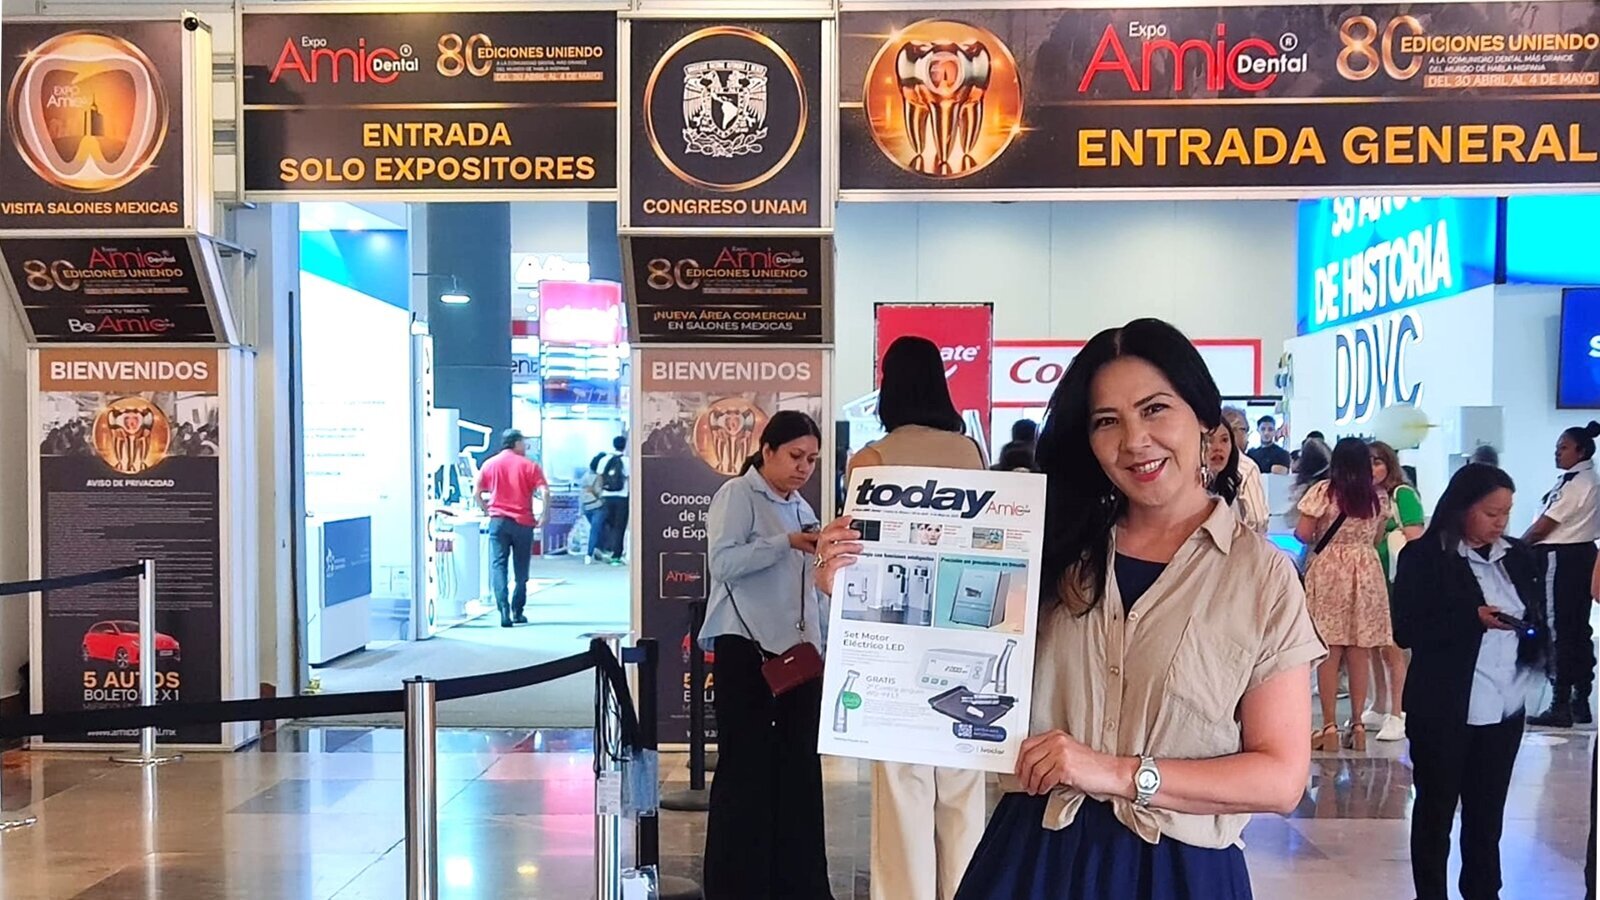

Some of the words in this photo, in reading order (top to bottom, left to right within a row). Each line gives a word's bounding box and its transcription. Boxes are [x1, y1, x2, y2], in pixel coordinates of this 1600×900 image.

[1129, 22, 1167, 37] Expo
[302, 36, 327, 48] Expo
[1336, 16, 1422, 80] 80
[1401, 35, 1504, 53] EDICIONES
[1509, 33, 1600, 51] UNIENDO
[269, 37, 400, 84] Amic
[373, 58, 419, 72] Dental
[436, 33, 493, 77] 80
[478, 47, 544, 59] EDICIONES
[546, 46, 603, 58] UNIENDO
[1078, 23, 1279, 91] Amic
[1237, 54, 1307, 75] Dental
[1495, 55, 1522, 63] DENTAL
[1429, 65, 1443, 73] DEL
[1444, 65, 1474, 73] MUNDO
[1487, 64, 1512, 72] HABLA
[1513, 64, 1546, 72] HISPANA
[1429, 76, 1451, 87] DEL
[1453, 75, 1471, 86] 30
[1473, 75, 1508, 86] ABRIL
[1510, 75, 1526, 85] AL
[1529, 74, 1538, 85] 4
[1540, 74, 1558, 84] DE
[1560, 73, 1595, 84] MAYO
[362, 122, 513, 147] ENTRADA
[1078, 126, 1327, 166] ENTRADA
[1342, 122, 1598, 164] GENERAL
[279, 158, 365, 182] SOLO
[375, 156, 596, 182] EXPOSITORES
[1, 202, 45, 215] VISITA
[47, 202, 112, 215] SALONES
[115, 201, 178, 214] MEXICAS
[643, 199, 748, 215] CONGRESO
[752, 199, 807, 214] UNAM
[89, 247, 164, 268] Amic
[714, 247, 792, 268] Amic
[23, 260, 80, 291] 80
[63, 269, 127, 278] EDICIONES
[129, 269, 183, 277] UNIENDO
[647, 258, 701, 290] 80
[686, 269, 750, 277] EDICIONES
[752, 269, 808, 278] UNIENDO
[1314, 261, 1340, 325] DE
[1342, 218, 1452, 317] HISTORIA
[654, 311, 697, 321] ¡NUEVA
[699, 310, 731, 319] ÁREA
[733, 311, 807, 320] COMERCIAL!
[68, 319, 96, 332] Be
[97, 316, 167, 332] Amic
[668, 322, 684, 331] EN
[686, 322, 738, 331] SALONES
[741, 322, 793, 331] MEXICAS
[942, 345, 978, 361] ate
[50, 361, 208, 380] BIENVENIDOS
[651, 361, 812, 380] BIENVENIDOS
[1009, 356, 1063, 384] Co
[1335, 308, 1424, 427] DDVC
[86, 480, 112, 488] AVISO
[113, 480, 124, 488] DE
[125, 480, 174, 488] PRIVACIDAD
[661, 492, 711, 505] Conoce
[856, 478, 996, 519] today
[679, 509, 696, 522] de
[663, 526, 679, 539] de
[844, 631, 859, 639] Set
[861, 632, 890, 641] Motor
[843, 639, 884, 650] Eléctrico
[886, 643, 905, 652] LED
[83, 671, 97, 688] 5
[103, 671, 180, 688] AUOS
[866, 675, 896, 685] GRATIS
